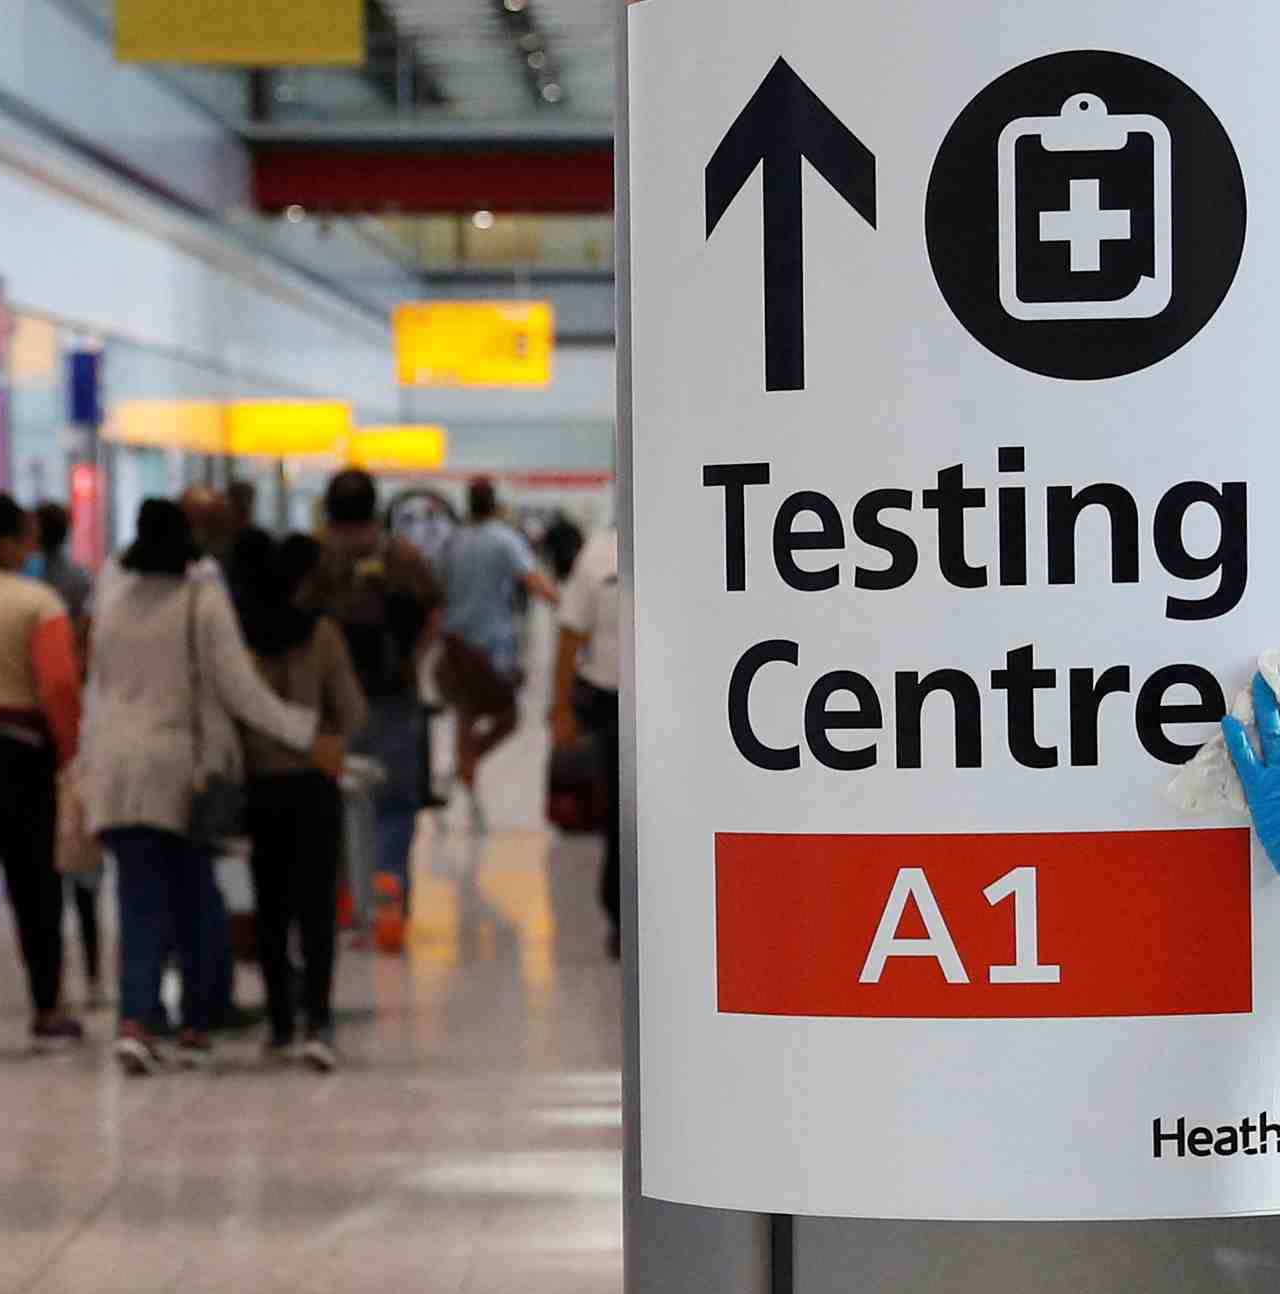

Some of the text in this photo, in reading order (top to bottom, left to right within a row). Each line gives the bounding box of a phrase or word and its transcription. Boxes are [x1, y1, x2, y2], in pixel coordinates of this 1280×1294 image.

[703, 446, 1248, 620] Testing
[728, 639, 1227, 770] Centre
[858, 866, 1061, 984] A1
